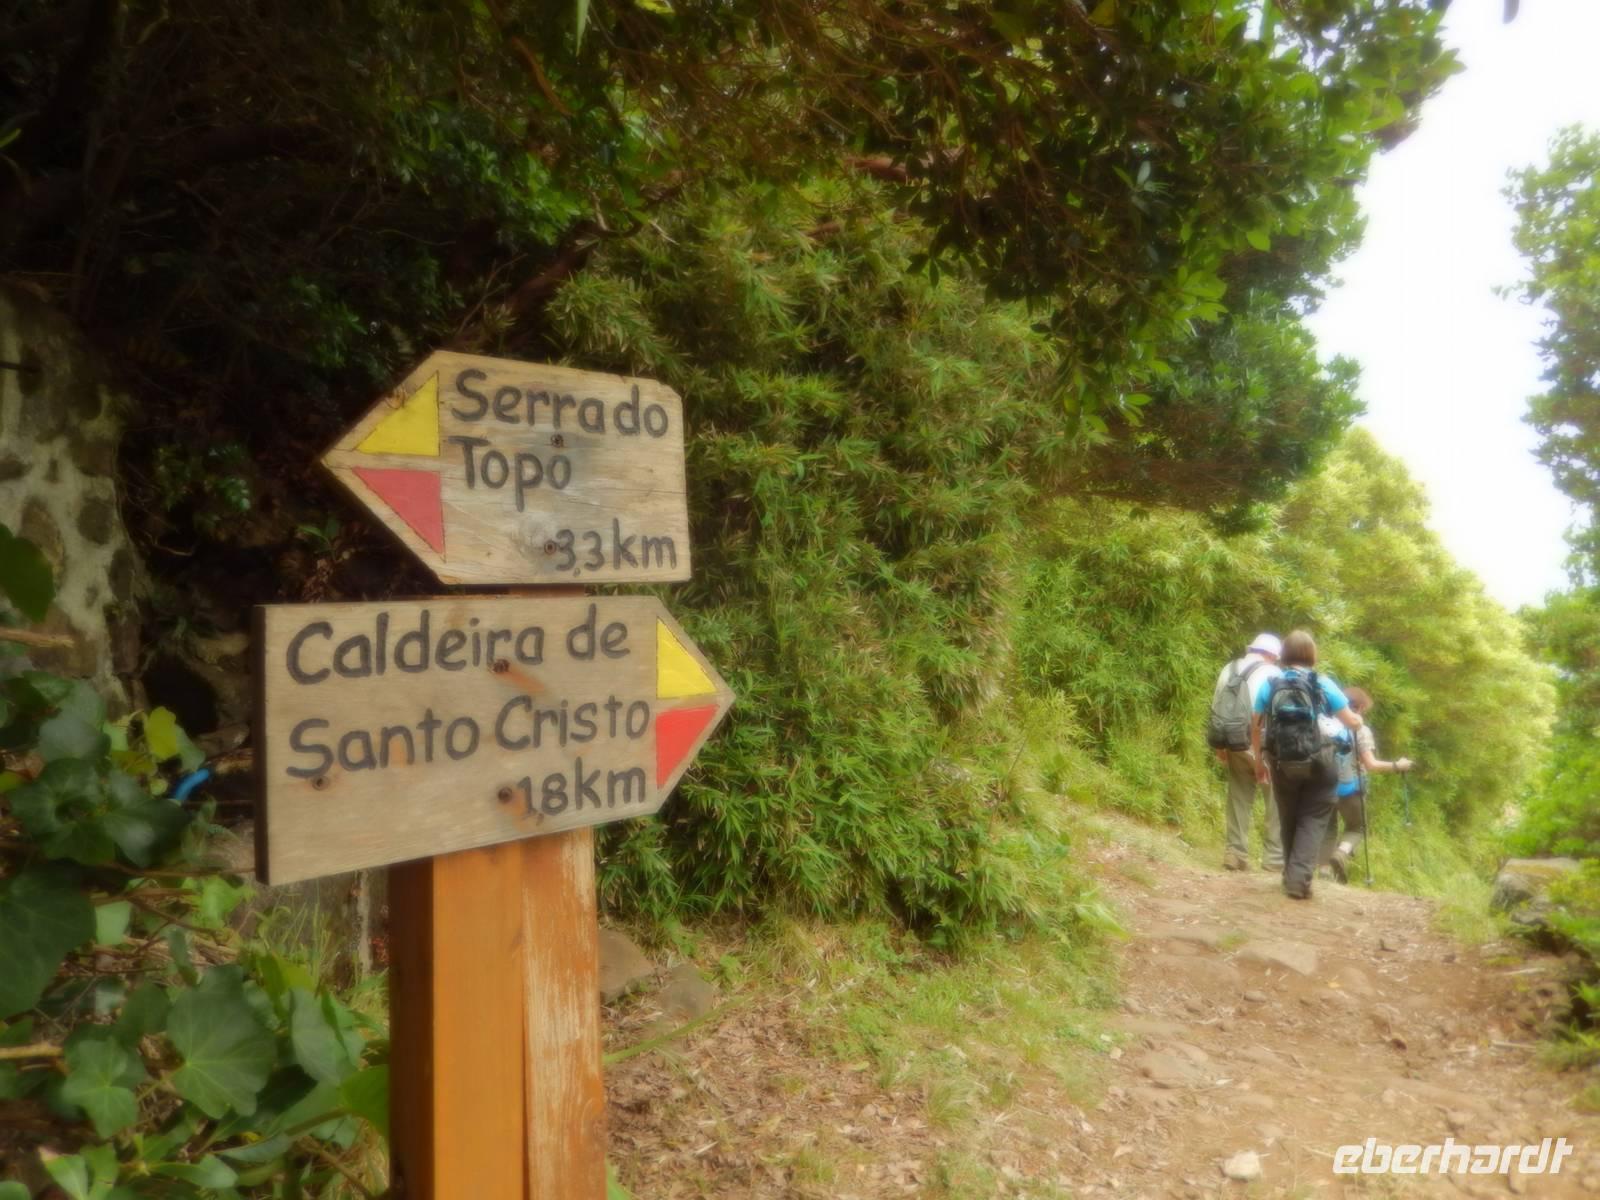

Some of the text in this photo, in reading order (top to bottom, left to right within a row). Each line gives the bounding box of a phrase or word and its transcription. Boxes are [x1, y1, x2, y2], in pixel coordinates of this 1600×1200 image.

[448, 435, 572, 512] Topo
[286, 603, 630, 685] Caldeira de
[287, 695, 650, 778] Santo Cristo
